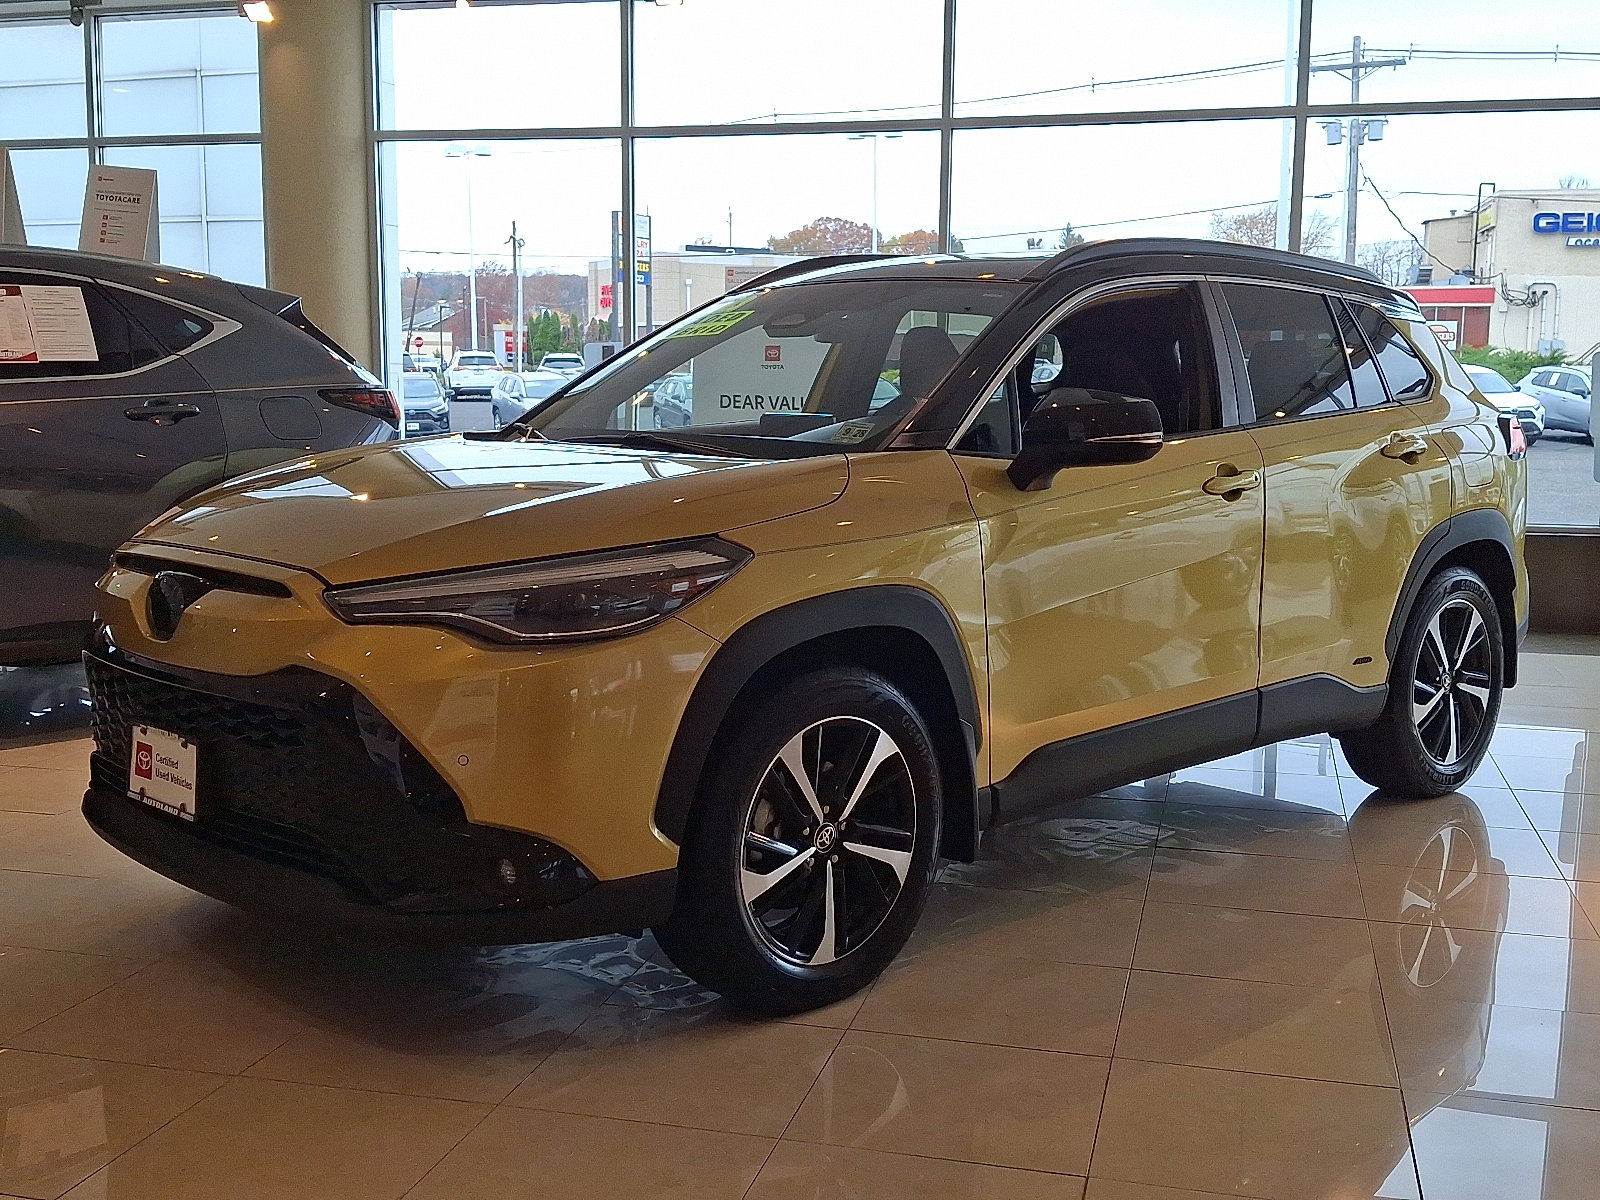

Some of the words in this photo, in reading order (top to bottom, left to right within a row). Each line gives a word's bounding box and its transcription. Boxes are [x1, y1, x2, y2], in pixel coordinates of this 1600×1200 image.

[96, 194, 141, 204] TOYOTACARE
[719, 394, 765, 410] DEAR
[155, 752, 179, 770] Certified
[155, 767, 170, 782] Used
[170, 772, 192, 790] Vehicles
[142, 796, 179, 816] AUTOLAND
